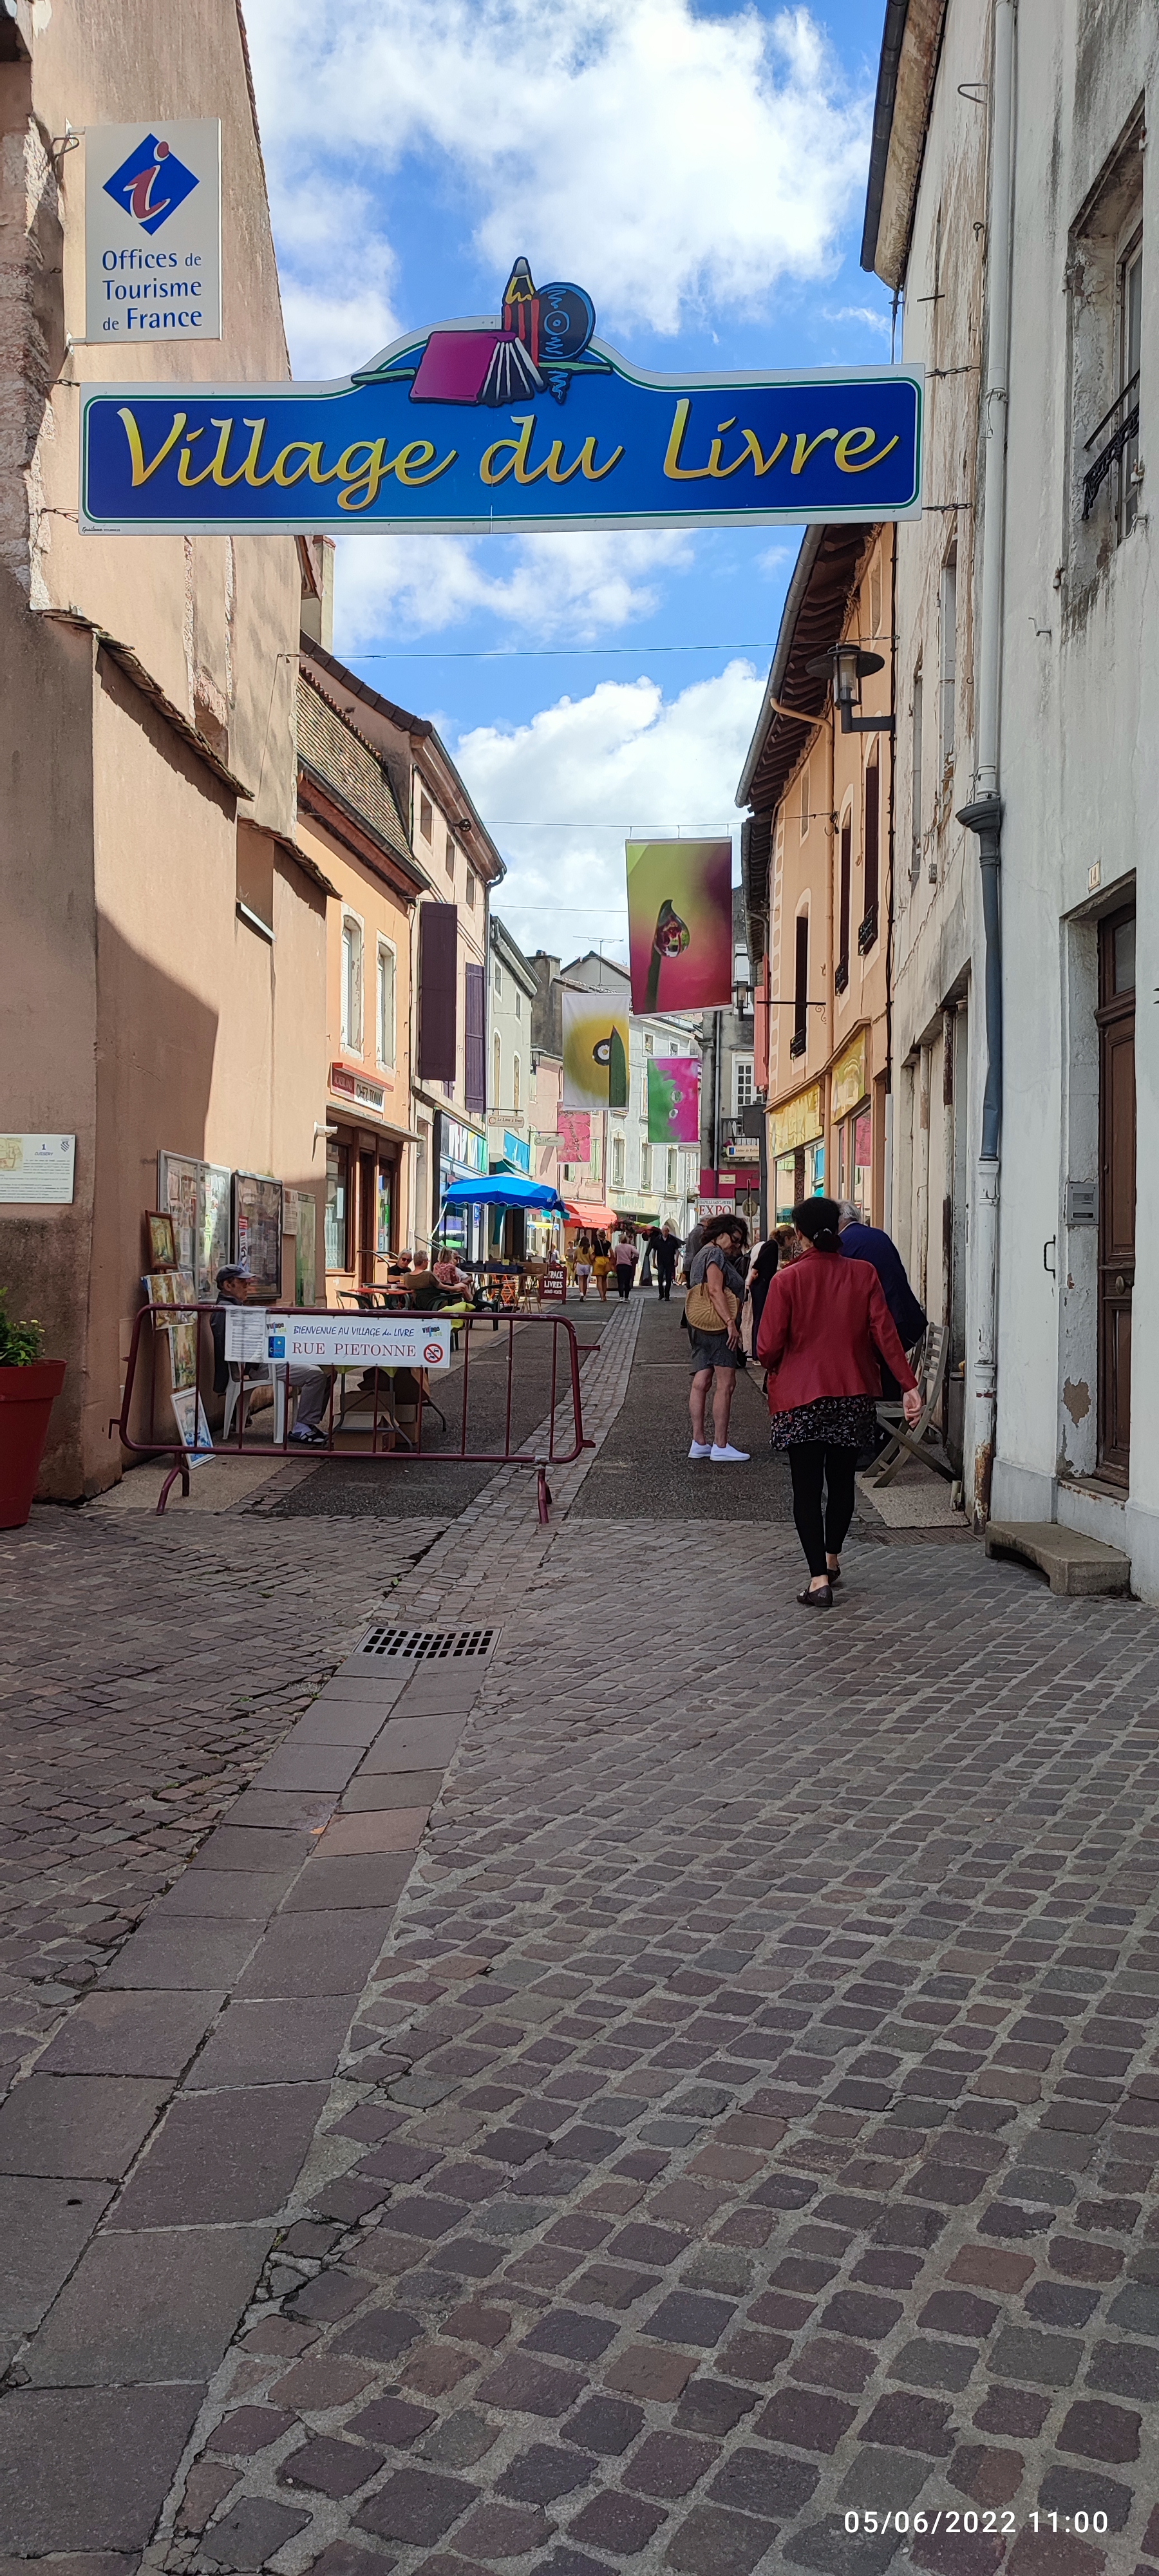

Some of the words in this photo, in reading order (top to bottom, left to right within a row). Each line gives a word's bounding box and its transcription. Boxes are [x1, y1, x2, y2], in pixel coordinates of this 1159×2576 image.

[102, 249, 178, 270] Offices
[185, 252, 202, 267] de
[102, 278, 203, 300] Tourisme
[102, 317, 120, 331] de
[127, 307, 203, 329] France
[116, 407, 457, 511] Village
[479, 414, 623, 486] du
[663, 397, 900, 482] Livre
[356, 1083, 368, 1102] CHEZ
[699, 1204, 731, 1216] EXPO
[544, 1280, 563, 1289] LIVRES
[294, 1325, 337, 1336] BIENVENUE
[338, 1326, 350, 1336] AU
[352, 1327, 381, 1337] VILLAGE
[382, 1328, 392, 1337] du
[394, 1328, 415, 1337] LIVRE
[292, 1341, 325, 1354] RUE
[334, 1343, 416, 1357] PIETONNE
